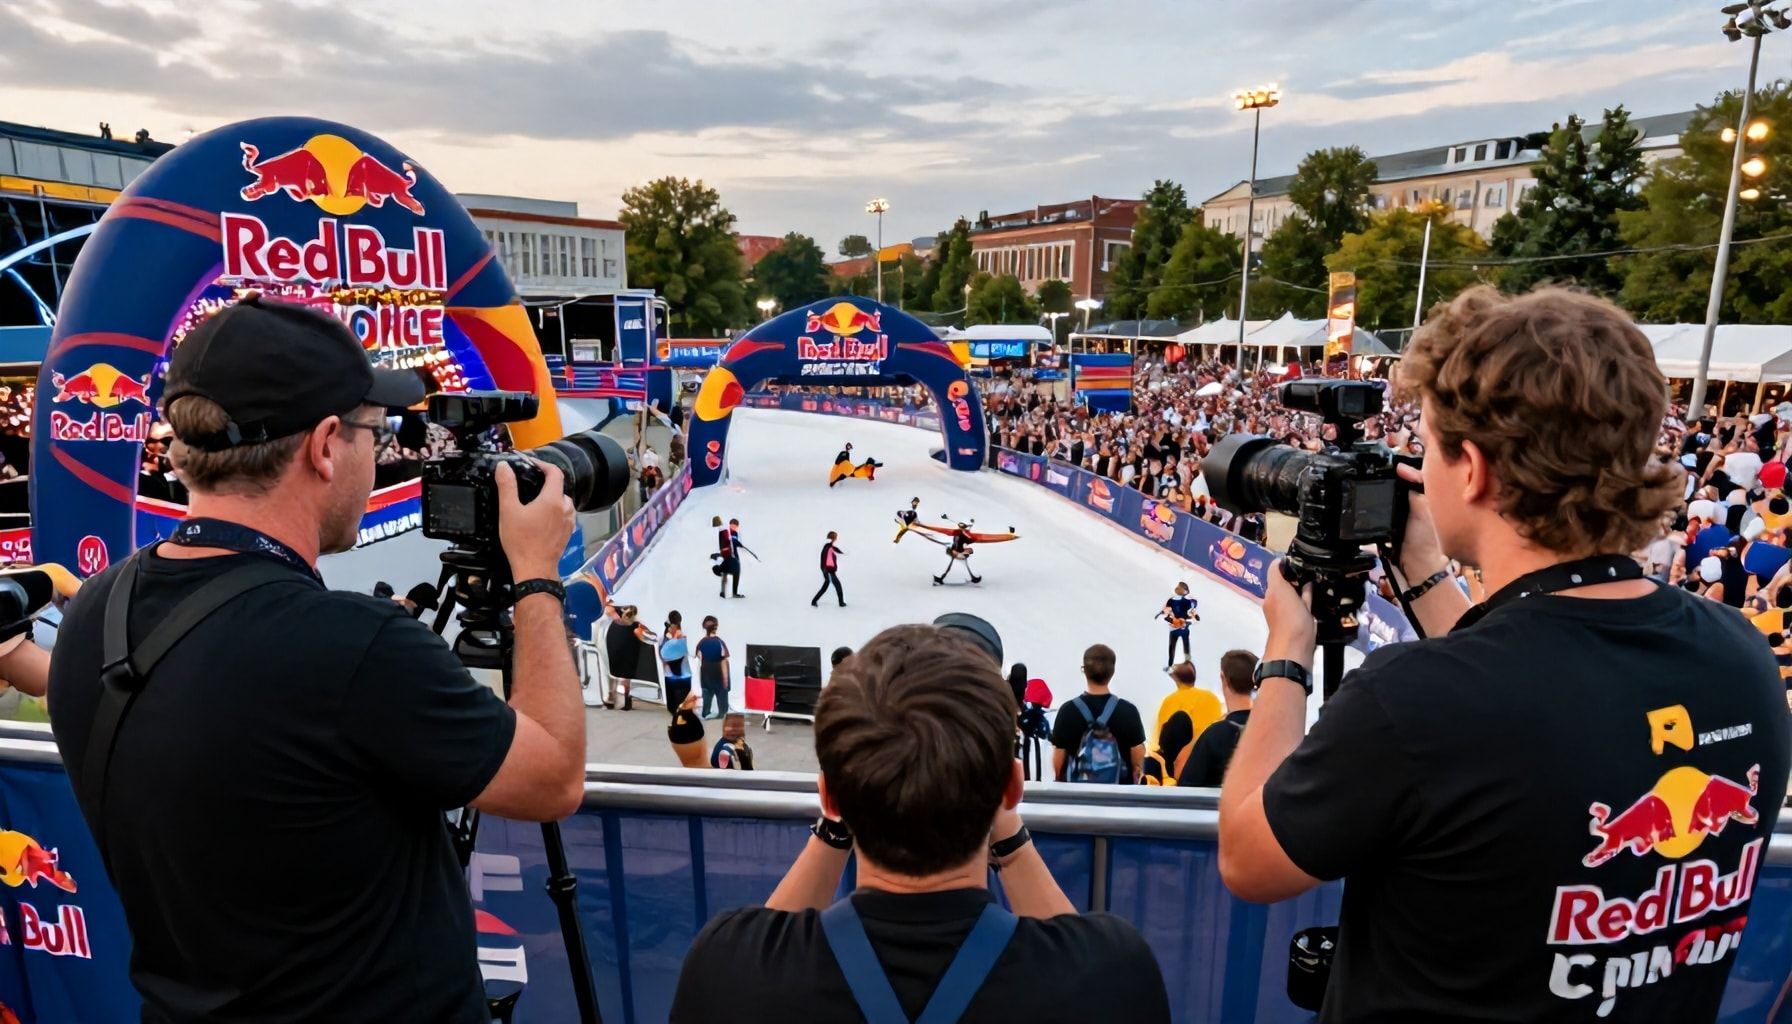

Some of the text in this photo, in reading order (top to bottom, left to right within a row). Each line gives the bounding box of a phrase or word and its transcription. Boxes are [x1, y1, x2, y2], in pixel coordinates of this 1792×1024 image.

[221, 212, 448, 291] Red Bull
[18, 901, 92, 960] Bull
[1546, 863, 1677, 945] Red
